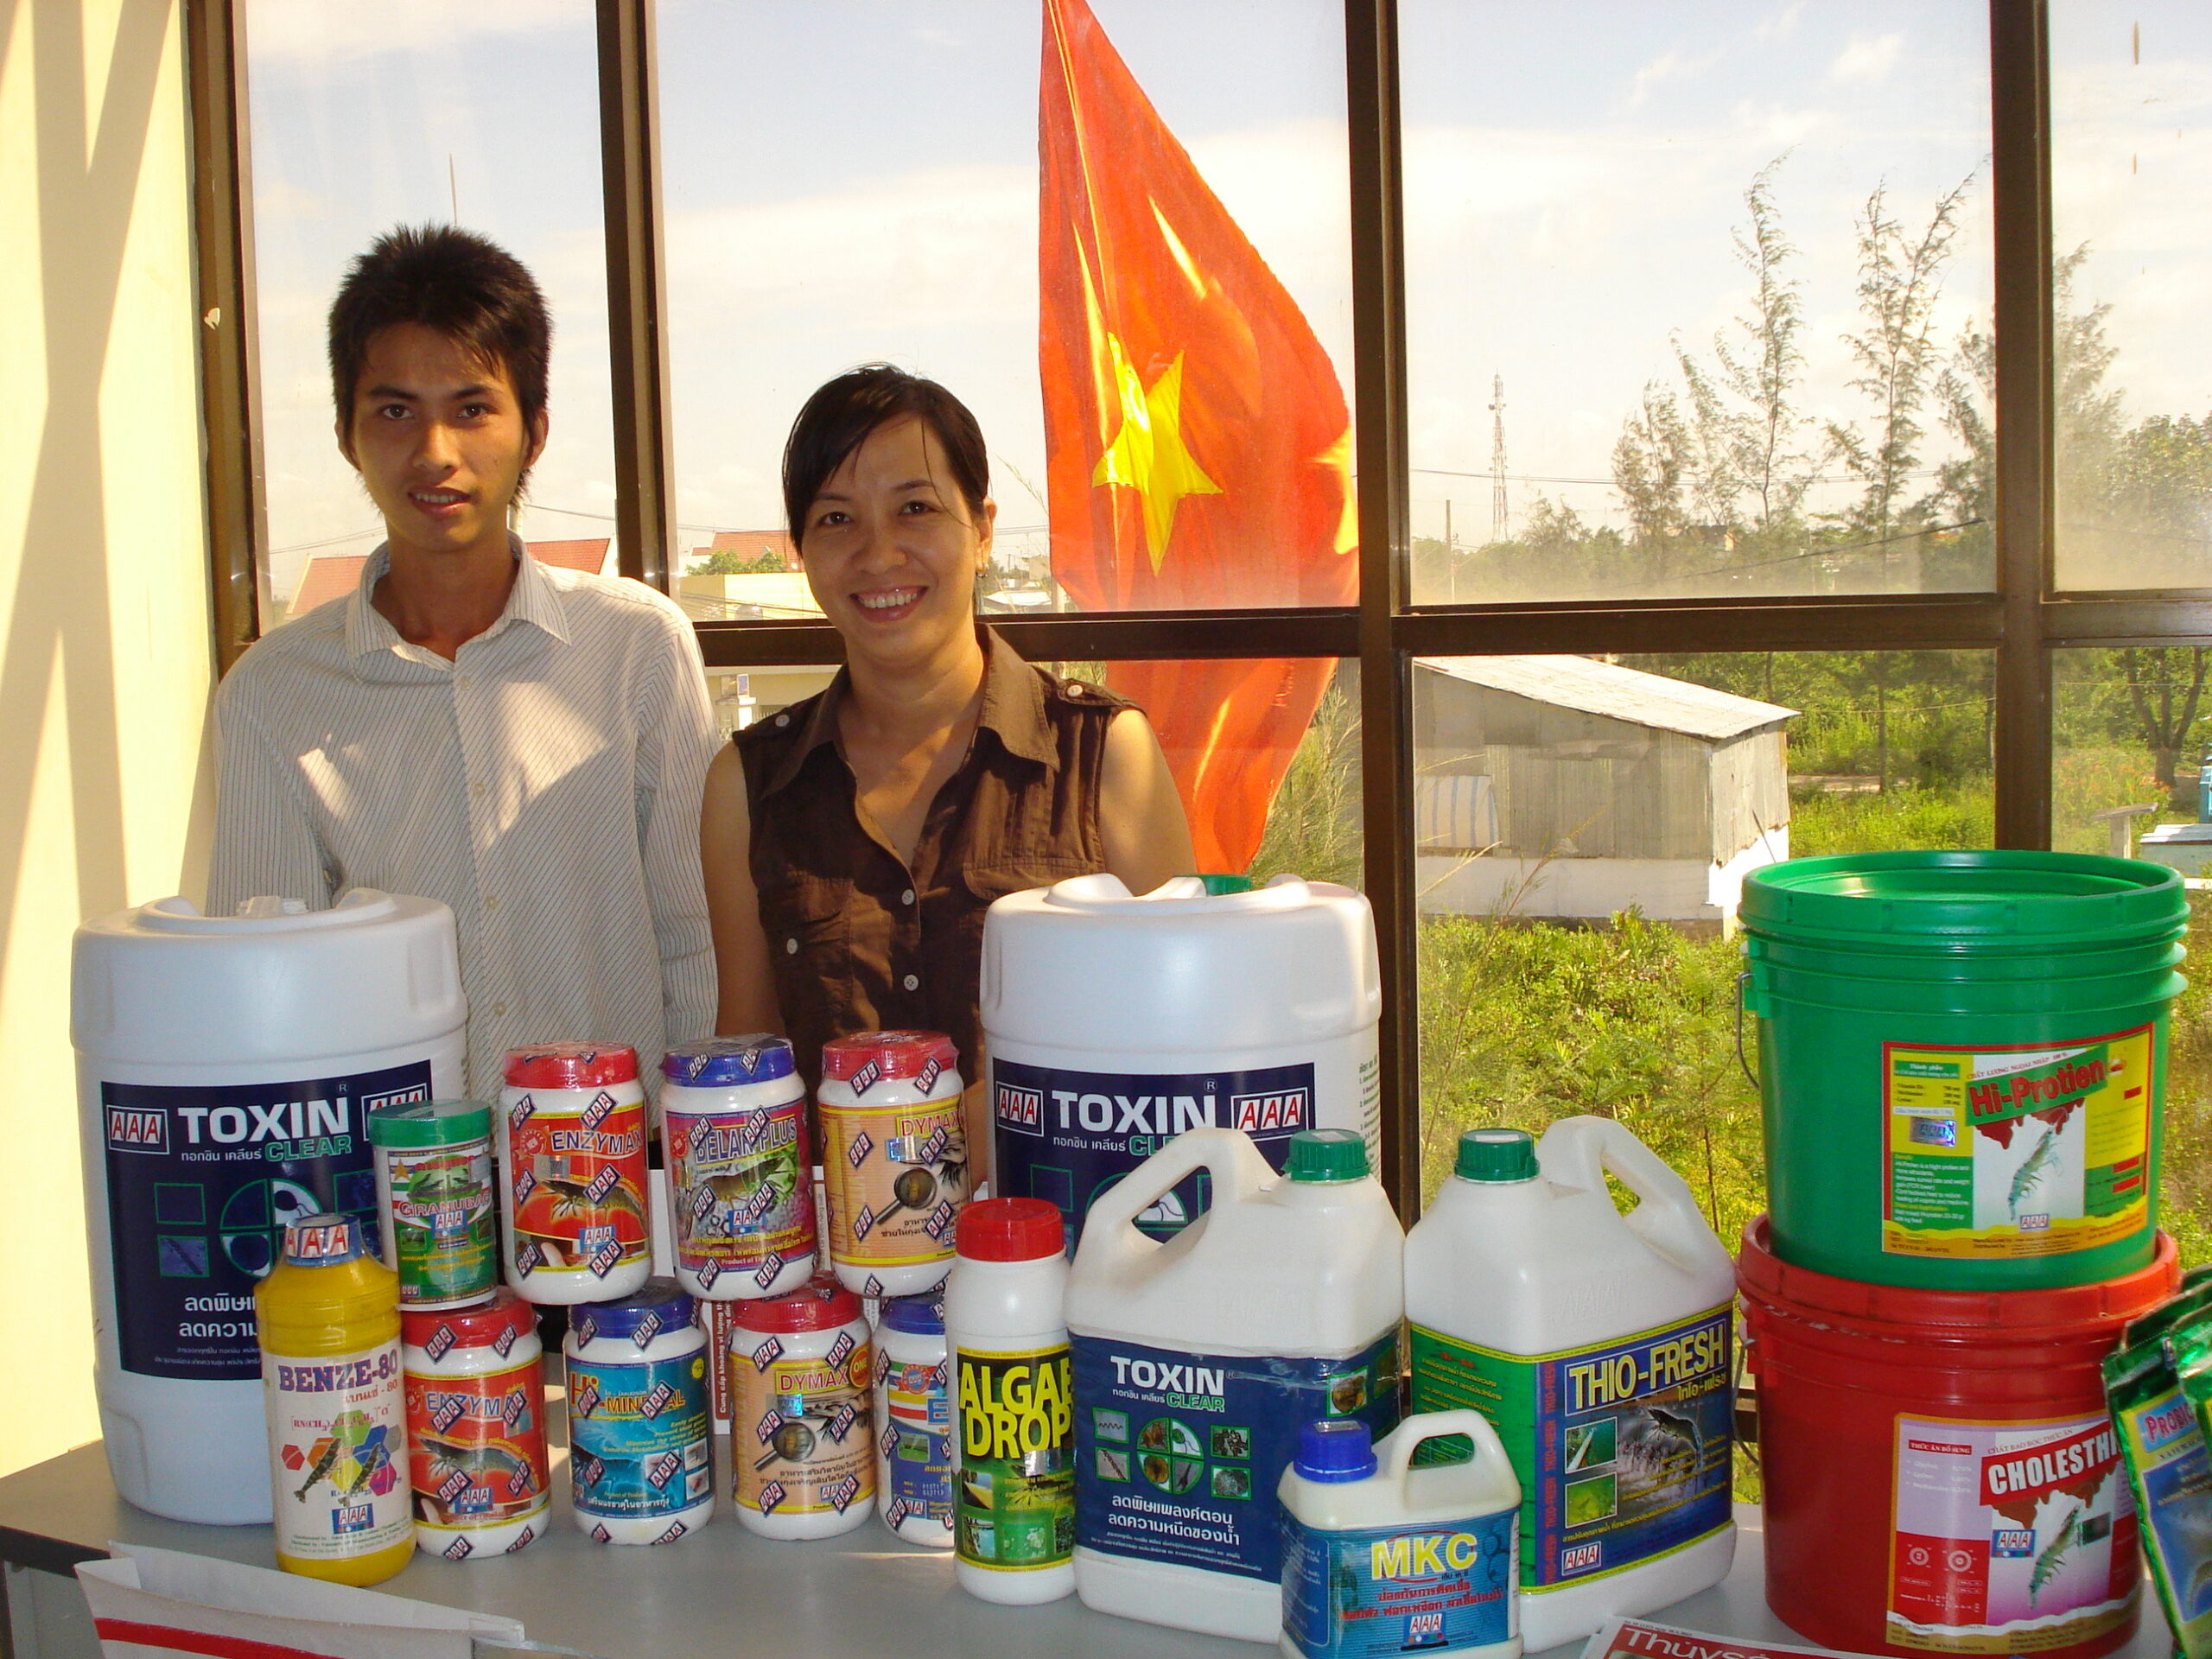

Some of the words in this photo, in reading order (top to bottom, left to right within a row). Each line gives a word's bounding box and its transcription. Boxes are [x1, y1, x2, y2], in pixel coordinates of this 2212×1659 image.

[852, 1061, 877, 1092] AAA
[917, 1059, 939, 1091] AAA
[1969, 1060, 2106, 1116] Hi-Protien
[178, 1097, 350, 1144] TOXIN
[585, 1093, 613, 1125] AAA
[901, 1110, 959, 1136] DYMAX
[998, 1089, 1038, 1125] AAA
[1052, 1090, 1216, 1135] TOXIN
[1238, 1094, 1302, 1131] AAA
[111, 1112, 161, 1144] AAA
[691, 1117, 709, 1146] AAA
[745, 1109, 768, 1142] AAA
[760, 1118, 797, 1151] PLUS
[264, 1135, 352, 1162] CLEAR
[551, 1129, 642, 1155] ENZYMAX
[849, 1135, 871, 1166] AAA
[923, 1128, 946, 1164] AAA
[589, 1166, 615, 1201] AAA
[748, 1182, 774, 1217] AAA
[694, 1186, 714, 1216] AAA
[435, 1211, 463, 1229] AAA
[855, 1207, 874, 1239] AAA
[928, 1201, 951, 1236] AAA
[2022, 1215, 2048, 1227] AAA
[584, 1228, 613, 1244] AAA
[594, 1243, 620, 1277] AAA
[699, 1260, 718, 1286] AAA
[757, 1254, 781, 1287] AAA
[426, 1325, 452, 1360] AAA
[494, 1325, 515, 1357] AAA
[635, 1312, 658, 1348] AAA
[753, 1338, 780, 1369] AAA
[826, 1332, 854, 1368] AAA
[278, 1349, 397, 1392] BENZE-80
[779, 1365, 849, 1392] DYMAX
[1110, 1356, 1225, 1396] TOXIN
[1568, 1324, 1725, 1410] THIO-FRESH
[642, 1382, 671, 1419] AAA
[960, 1357, 1072, 1414] ALGAE
[432, 1399, 461, 1431] AAA
[505, 1391, 524, 1426] AAA
[1166, 1392, 1225, 1413] CLEAR
[758, 1410, 782, 1442] AAA
[830, 1404, 855, 1442] AAA
[966, 1403, 1071, 1459] DROP
[650, 1452, 677, 1488] AAA
[440, 1471, 468, 1502] AAA
[461, 1487, 489, 1504] AAA
[760, 1482, 783, 1513] AAA
[834, 1475, 859, 1511] AAA
[340, 1507, 367, 1524] AAA
[1371, 1533, 1478, 1580] MKC
[1566, 1545, 1599, 1568] AAA
[1998, 1533, 2031, 1548] AAA
[1410, 1614, 1442, 1633] AAA
